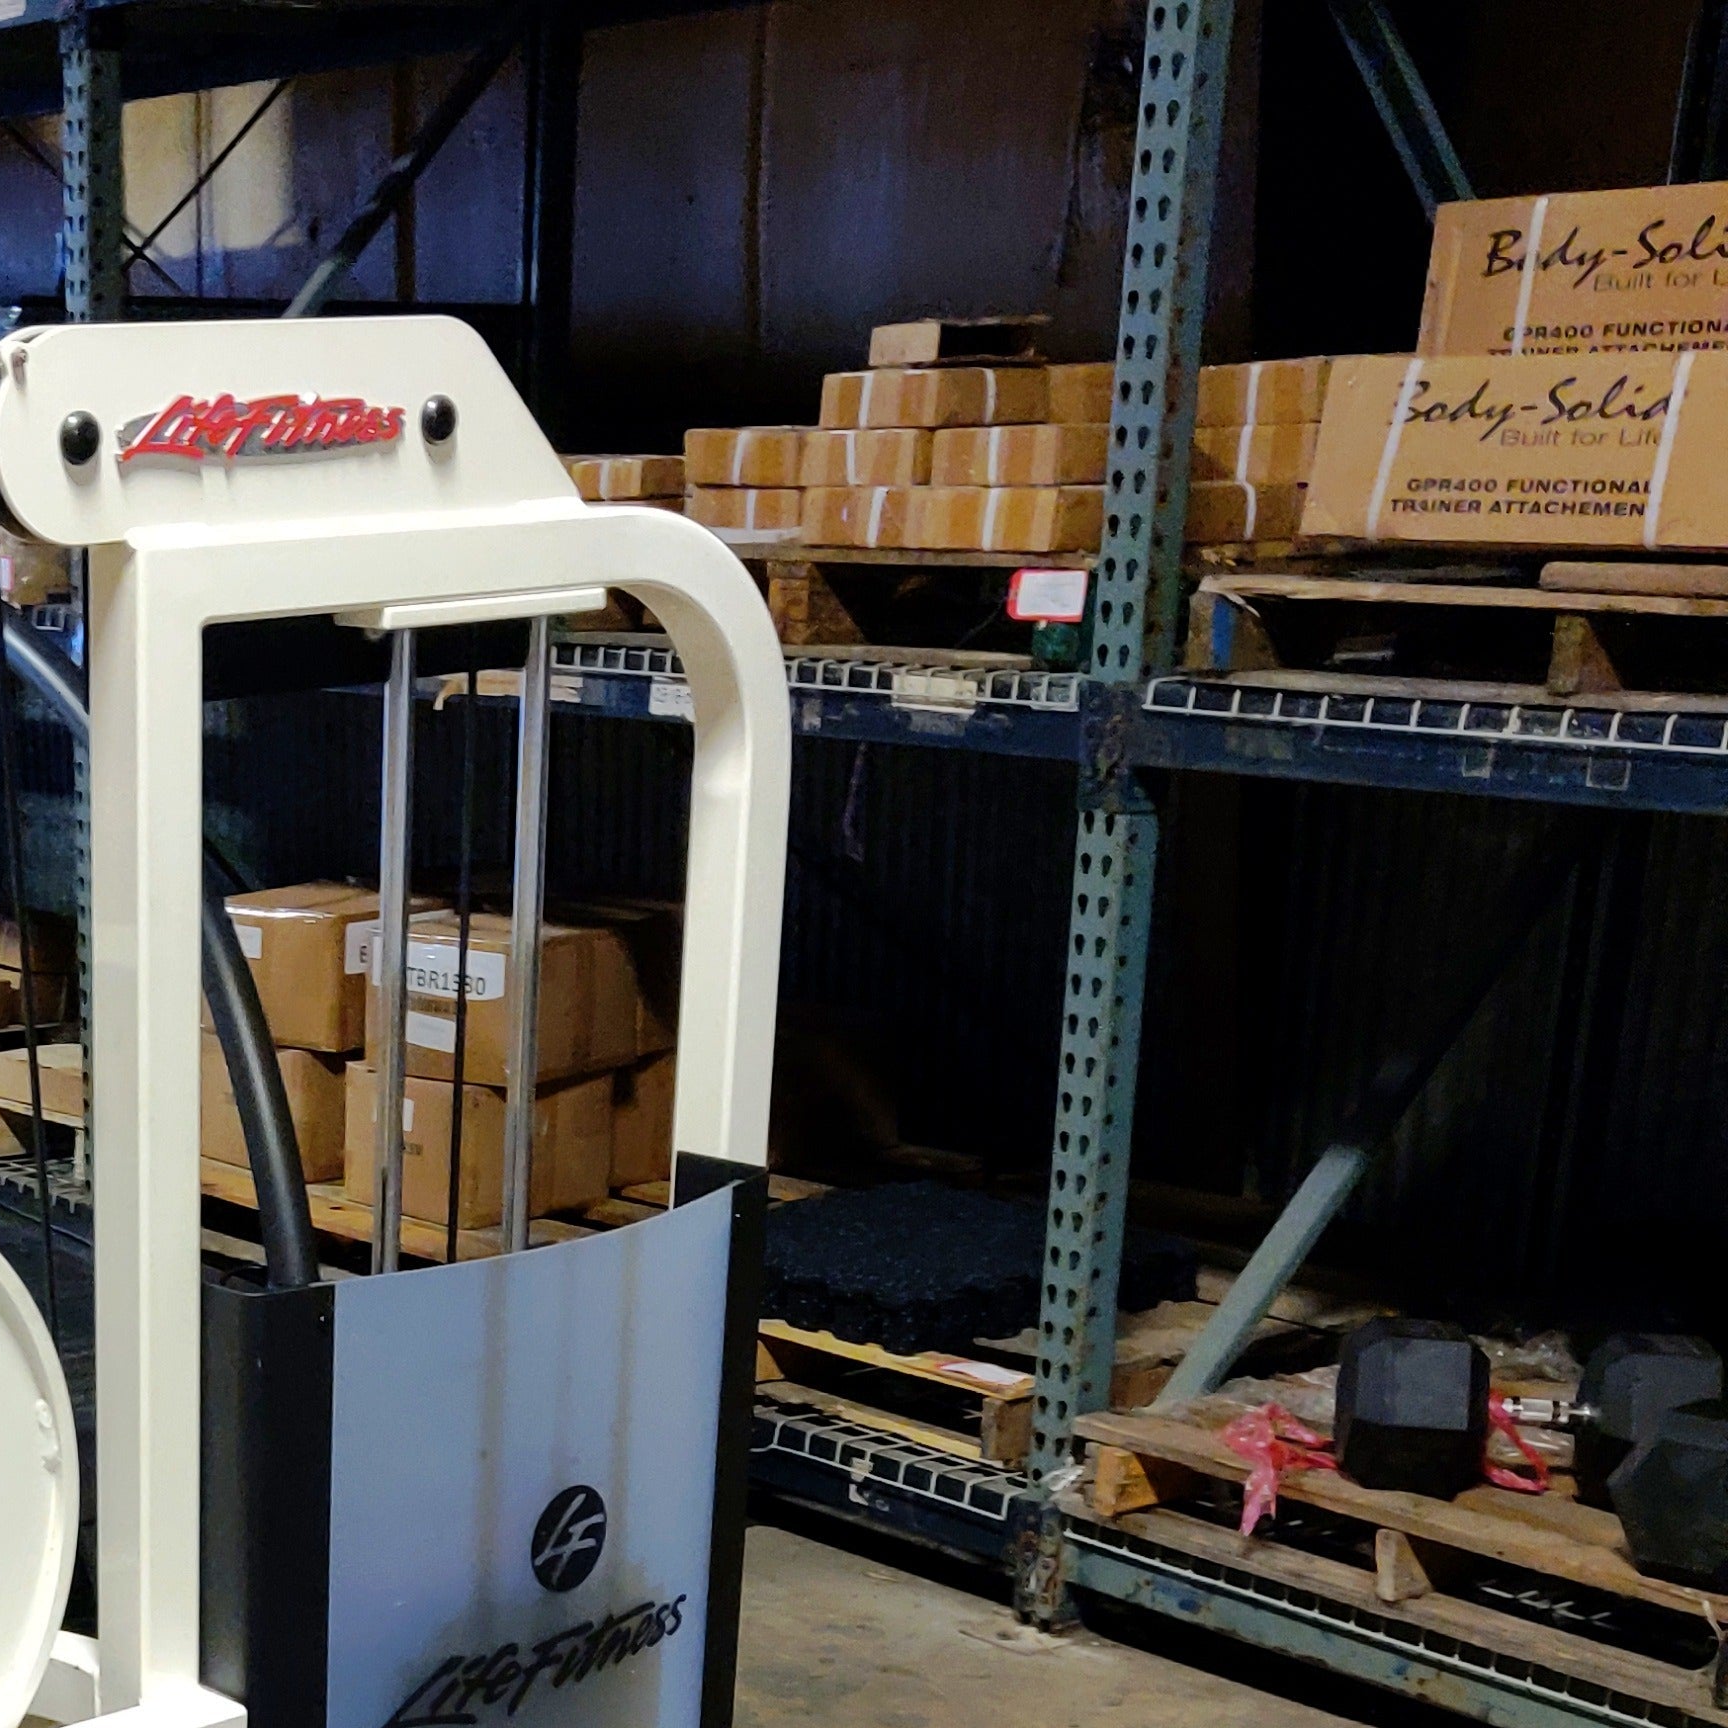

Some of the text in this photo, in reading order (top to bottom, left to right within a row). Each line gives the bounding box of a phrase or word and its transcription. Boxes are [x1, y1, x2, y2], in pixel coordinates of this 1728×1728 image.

[1593, 272, 1651, 292] Built
[1665, 271, 1701, 287] for
[1603, 318, 1728, 338] FUNCTION
[1500, 429, 1559, 447] Built
[1571, 428, 1608, 446] for
[1391, 498, 1645, 517] TRAINER ATTACHEMEN
